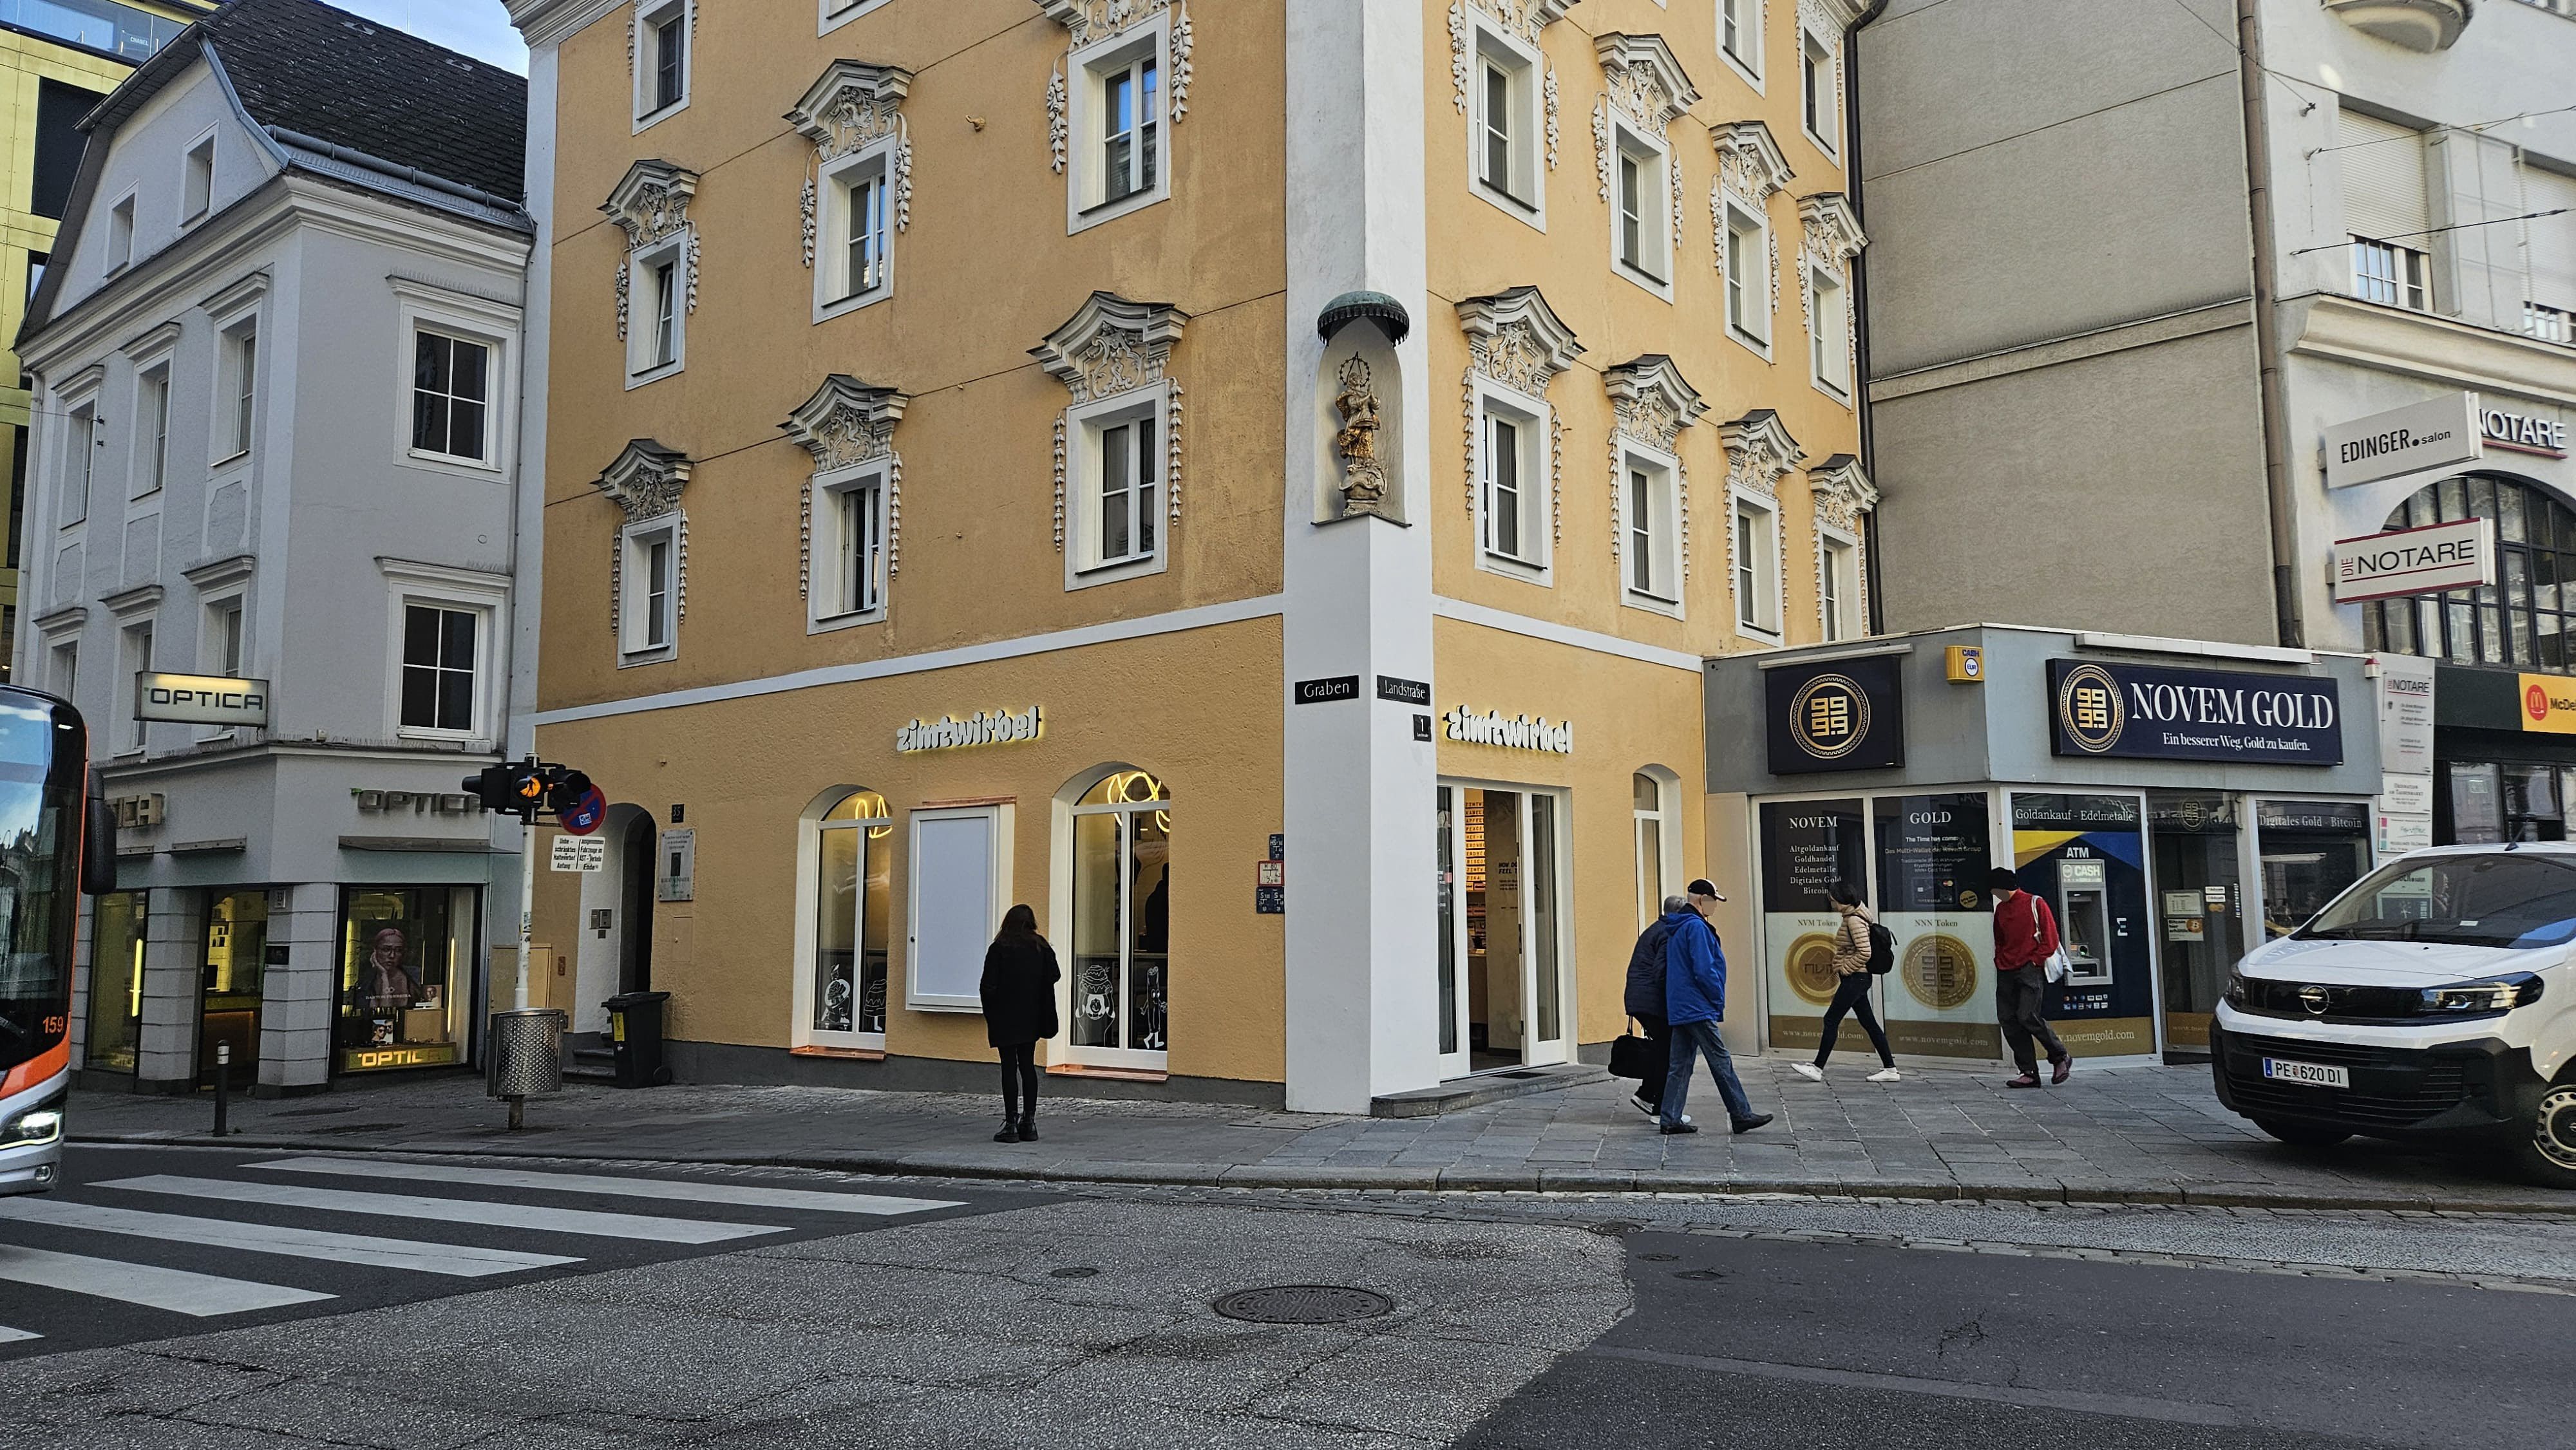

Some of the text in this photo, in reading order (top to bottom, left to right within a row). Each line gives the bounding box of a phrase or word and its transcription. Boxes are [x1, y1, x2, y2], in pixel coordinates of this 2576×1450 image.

[2479, 407, 2567, 449] NOTARE
[2341, 539, 2474, 576] DIE NOTARE
[1303, 681, 1350, 697] Graben
[1385, 679, 1426, 699] Landstraße
[2393, 679, 2430, 693] NOTARE
[150, 688, 263, 710] OPTICA
[2130, 683, 2333, 729] NOVEM GOLD
[896, 705, 1041, 752] zimtwirbel
[1420, 718, 1424, 732] 1
[1445, 704, 1573, 754] zimtwirbel
[2163, 732, 2311, 751] Ein besserer Weg, Gold zu kaufen.
[1788, 816, 1839, 829] NOVEM
[1909, 811, 1952, 824] GOLD
[2015, 809, 2072, 821] Goldankauf
[2080, 810, 2134, 822] Edelmetalle
[2259, 814, 2300, 828] Digitales
[2302, 815, 2322, 827] Gold
[2331, 816, 2363, 829] Bitcoin
[1789, 844, 1841, 854] Altgoldankauf
[2066, 847, 2090, 858] ATM
[1794, 854, 1835, 863] Goldhandel
[1794, 865, 1837, 874] Edelmetalle
[2074, 865, 2100, 876] CASH
[1790, 876, 1823, 886] Digitales
[43, 1016, 64, 1035] 159
[1900, 1035, 1989, 1047] www.novemgold.com
[2275, 1062, 2341, 1084] PE 620 DI
